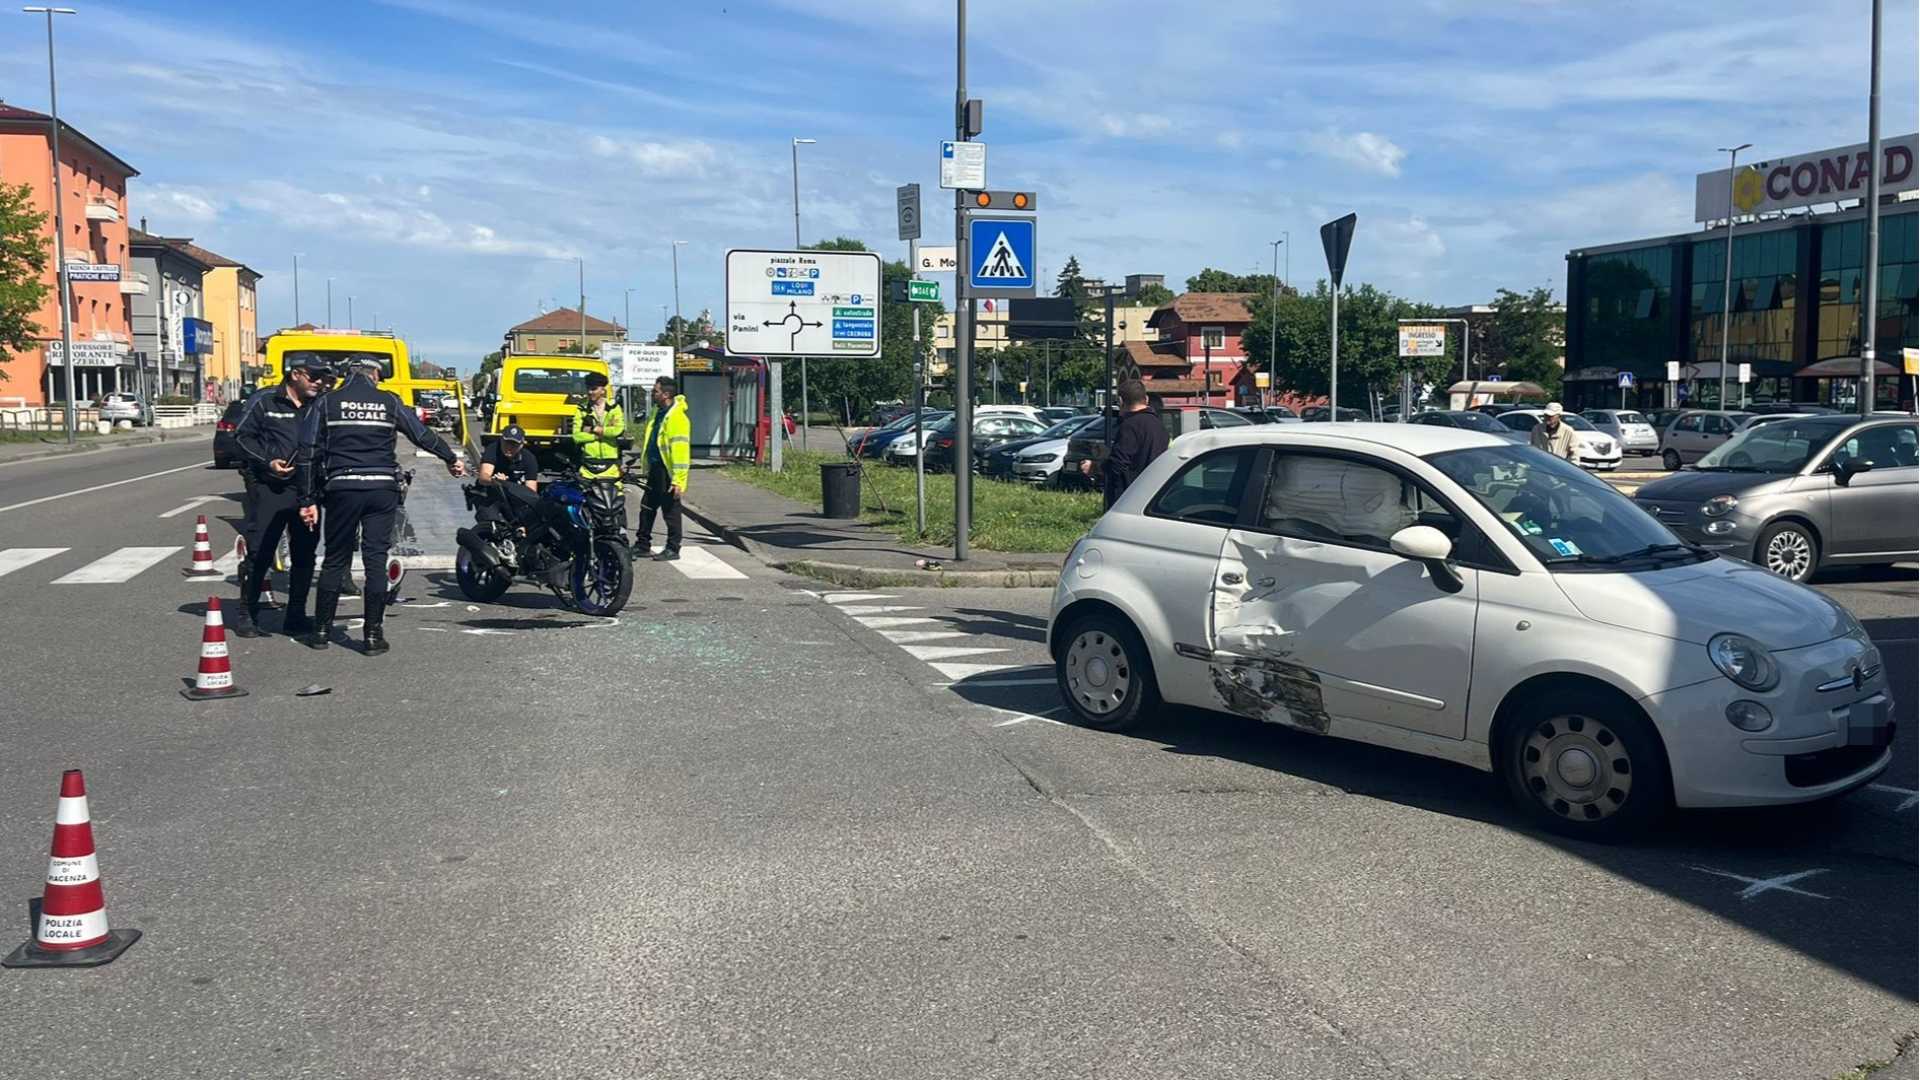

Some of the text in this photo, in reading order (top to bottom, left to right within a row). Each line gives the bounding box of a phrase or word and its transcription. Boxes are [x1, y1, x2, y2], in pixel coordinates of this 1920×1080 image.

[1766, 145, 1913, 201] CONAD
[922, 259, 957, 268] G. Mo
[732, 325, 759, 333] Panini
[52, 351, 112, 359] RIORANTE
[341, 402, 387, 411] POLIZIA
[341, 411, 387, 420] LOCALE
[48, 874, 87, 882] PIACENZA
[45, 919, 82, 927] POLIZIA
[44, 930, 81, 938] LOCALE
